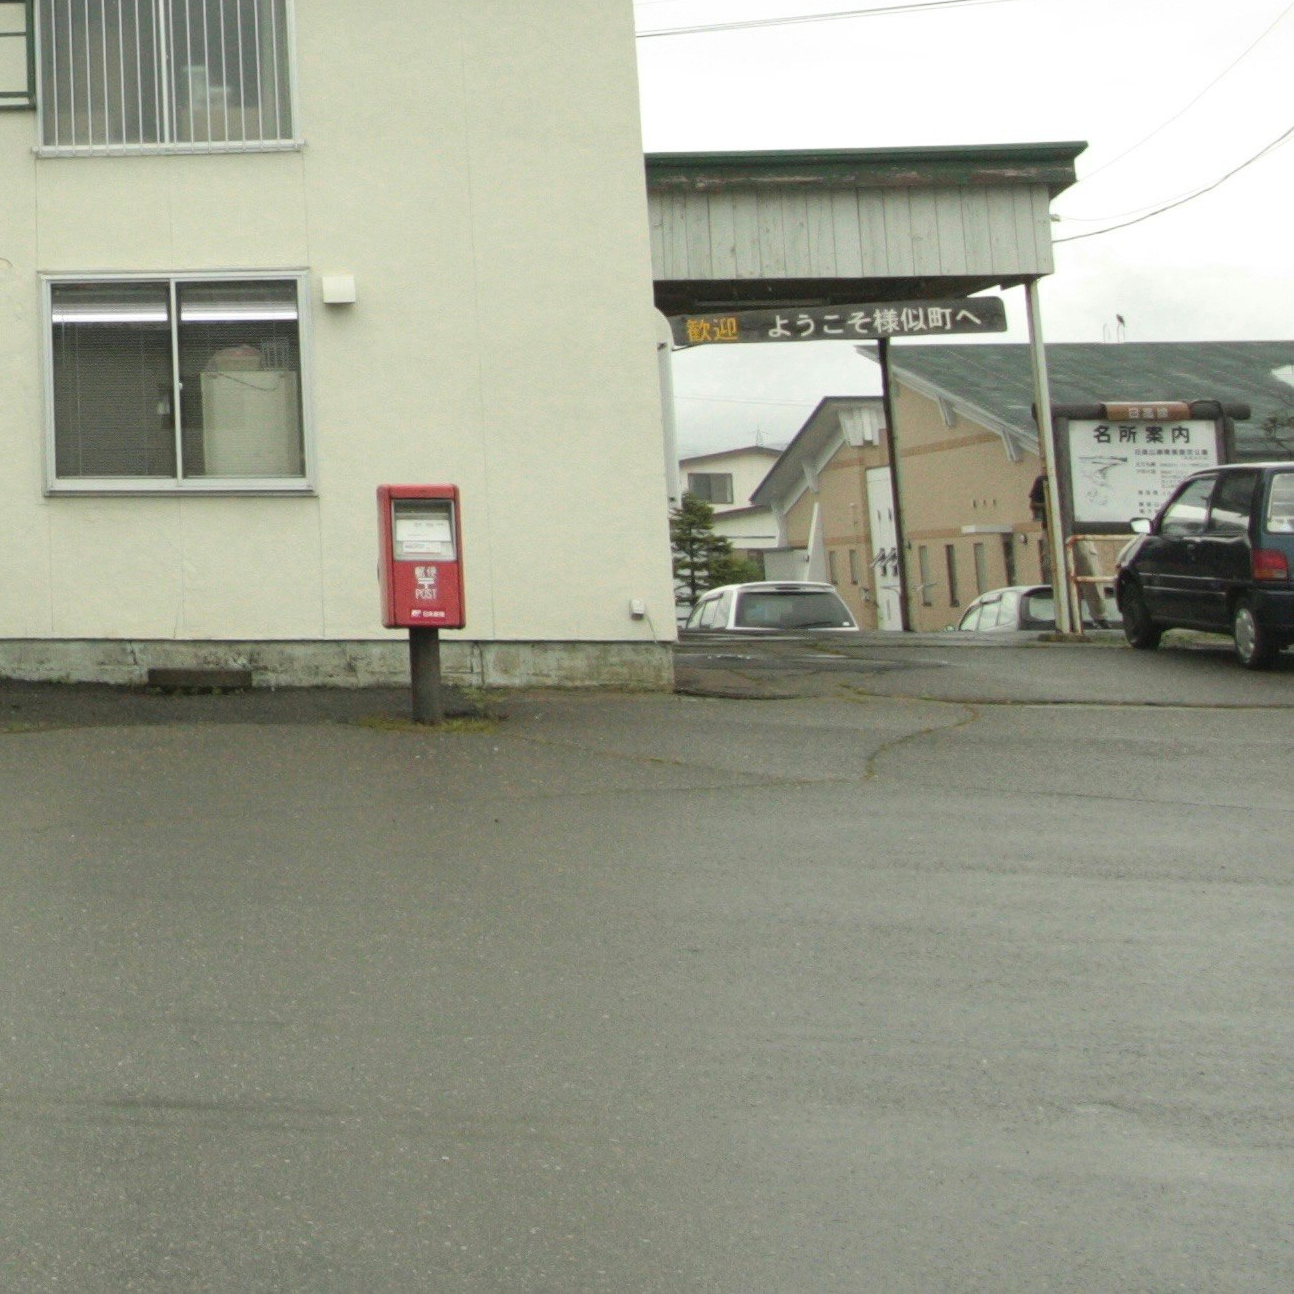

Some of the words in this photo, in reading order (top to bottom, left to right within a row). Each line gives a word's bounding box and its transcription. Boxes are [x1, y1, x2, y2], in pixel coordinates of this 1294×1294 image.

[687, 317, 738, 342] 歓迎
[767, 307, 982, 338] ようこそ様似町へ
[1094, 425, 1190, 443] 名所案内
[415, 588, 437, 600] POST
